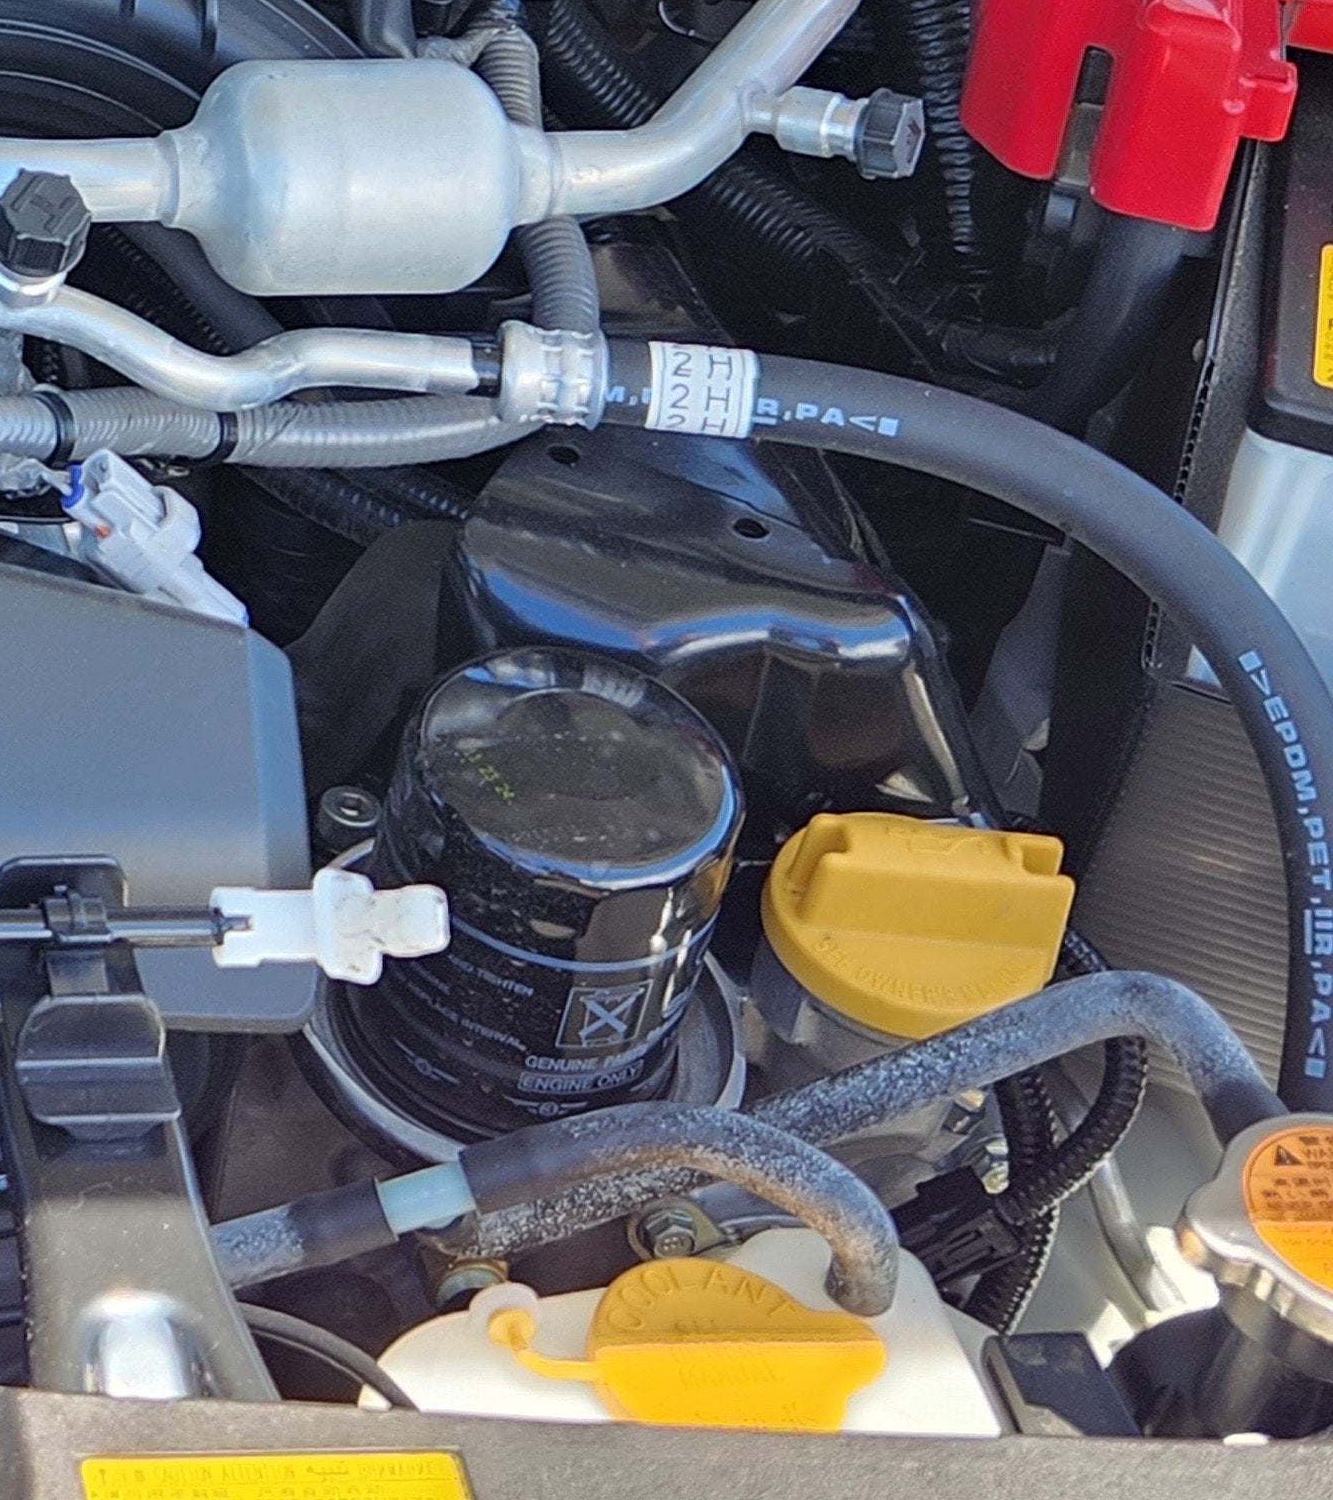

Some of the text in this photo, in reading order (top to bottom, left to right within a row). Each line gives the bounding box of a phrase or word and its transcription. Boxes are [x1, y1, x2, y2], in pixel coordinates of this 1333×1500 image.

[668, 383, 730, 413] 2 H
[521, 1065, 641, 1091] ENGINE ONLY
[524, 1055, 599, 1073] GENUINE
[607, 1266, 796, 1331] COOLANT
